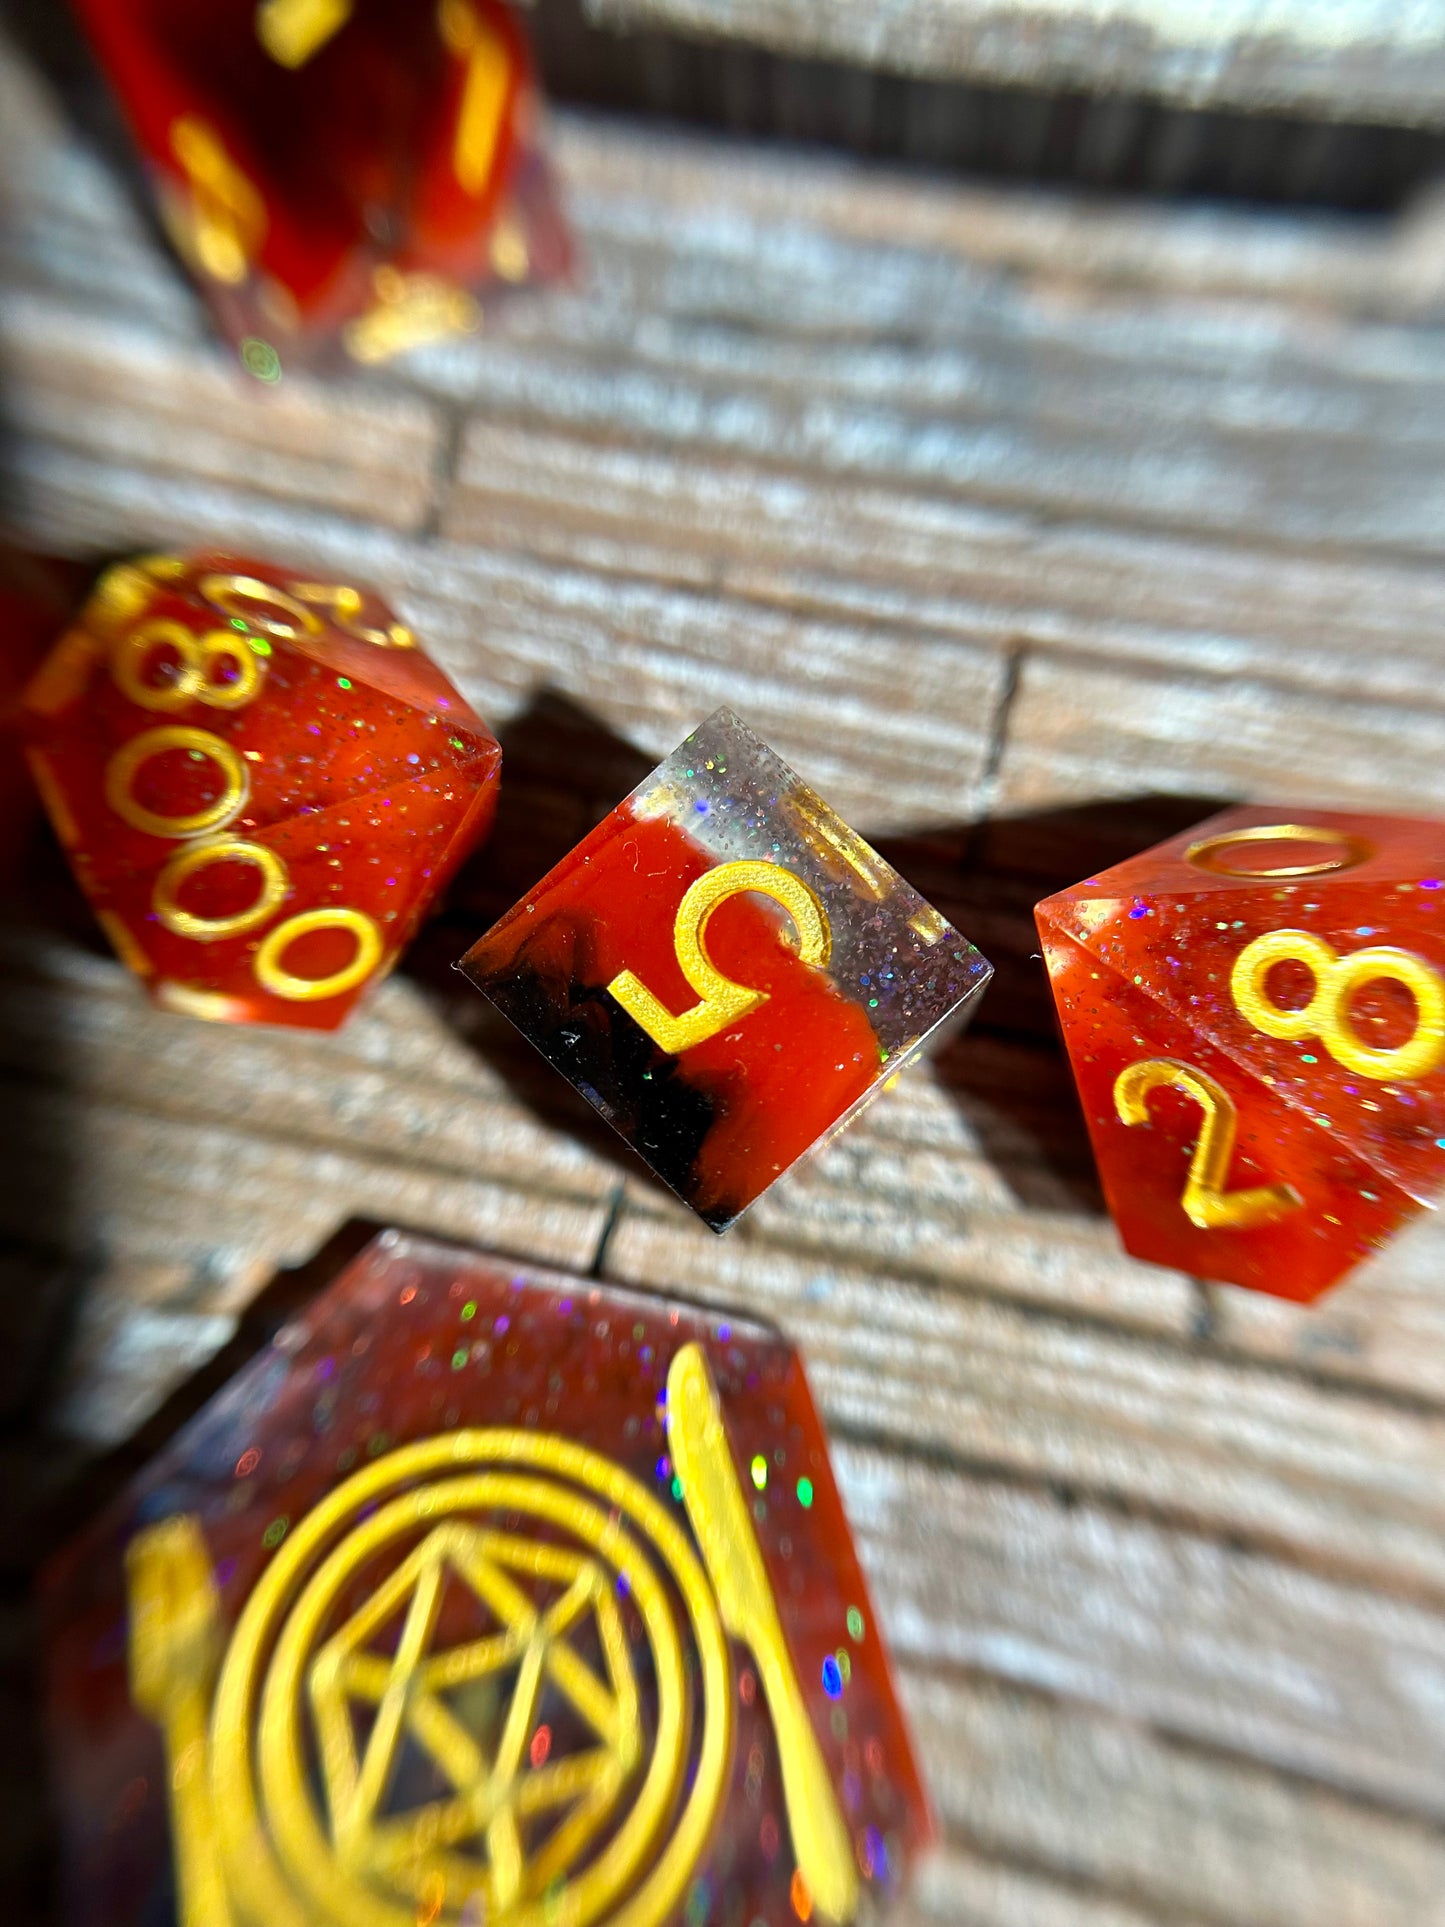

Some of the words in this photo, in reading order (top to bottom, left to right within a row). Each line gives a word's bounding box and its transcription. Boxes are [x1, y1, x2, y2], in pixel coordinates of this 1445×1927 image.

[105, 617, 261, 838] 80
[152, 836, 383, 1001] 00
[1184, 824, 1377, 880] 0
[606, 861, 832, 1054] 5
[1231, 929, 1445, 1081] 8
[1113, 1057, 1304, 1228] 2
